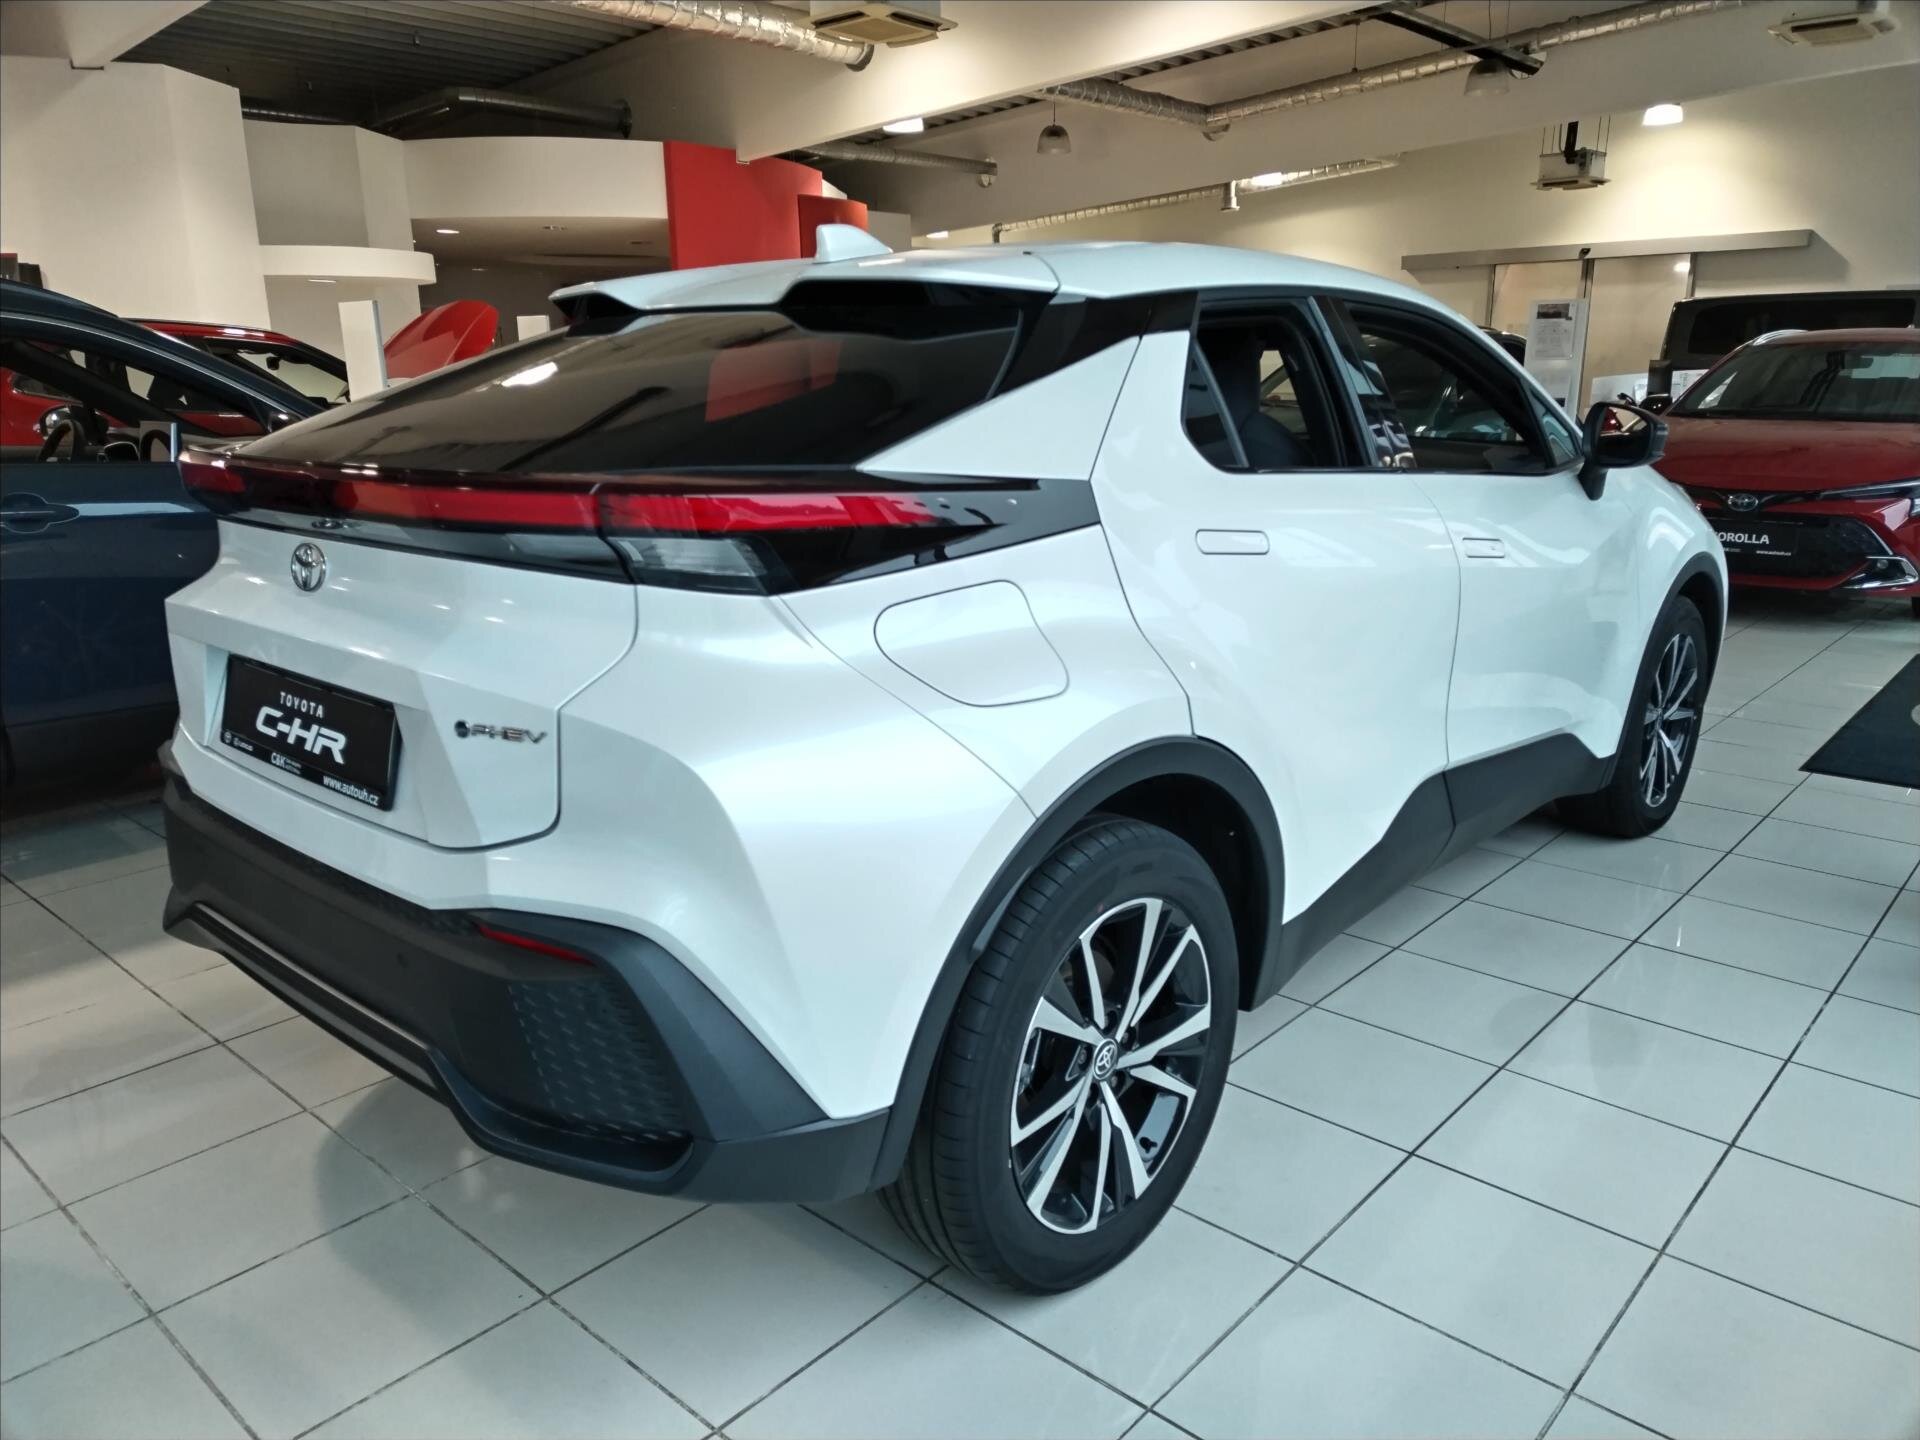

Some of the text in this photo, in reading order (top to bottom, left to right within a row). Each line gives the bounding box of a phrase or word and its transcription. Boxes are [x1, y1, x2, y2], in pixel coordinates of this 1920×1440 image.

[1715, 532, 1769, 545] OROLLA
[280, 691, 324, 718] TOYOTA
[255, 705, 347, 765] C-HR
[323, 775, 380, 806] www.autouh.cz
